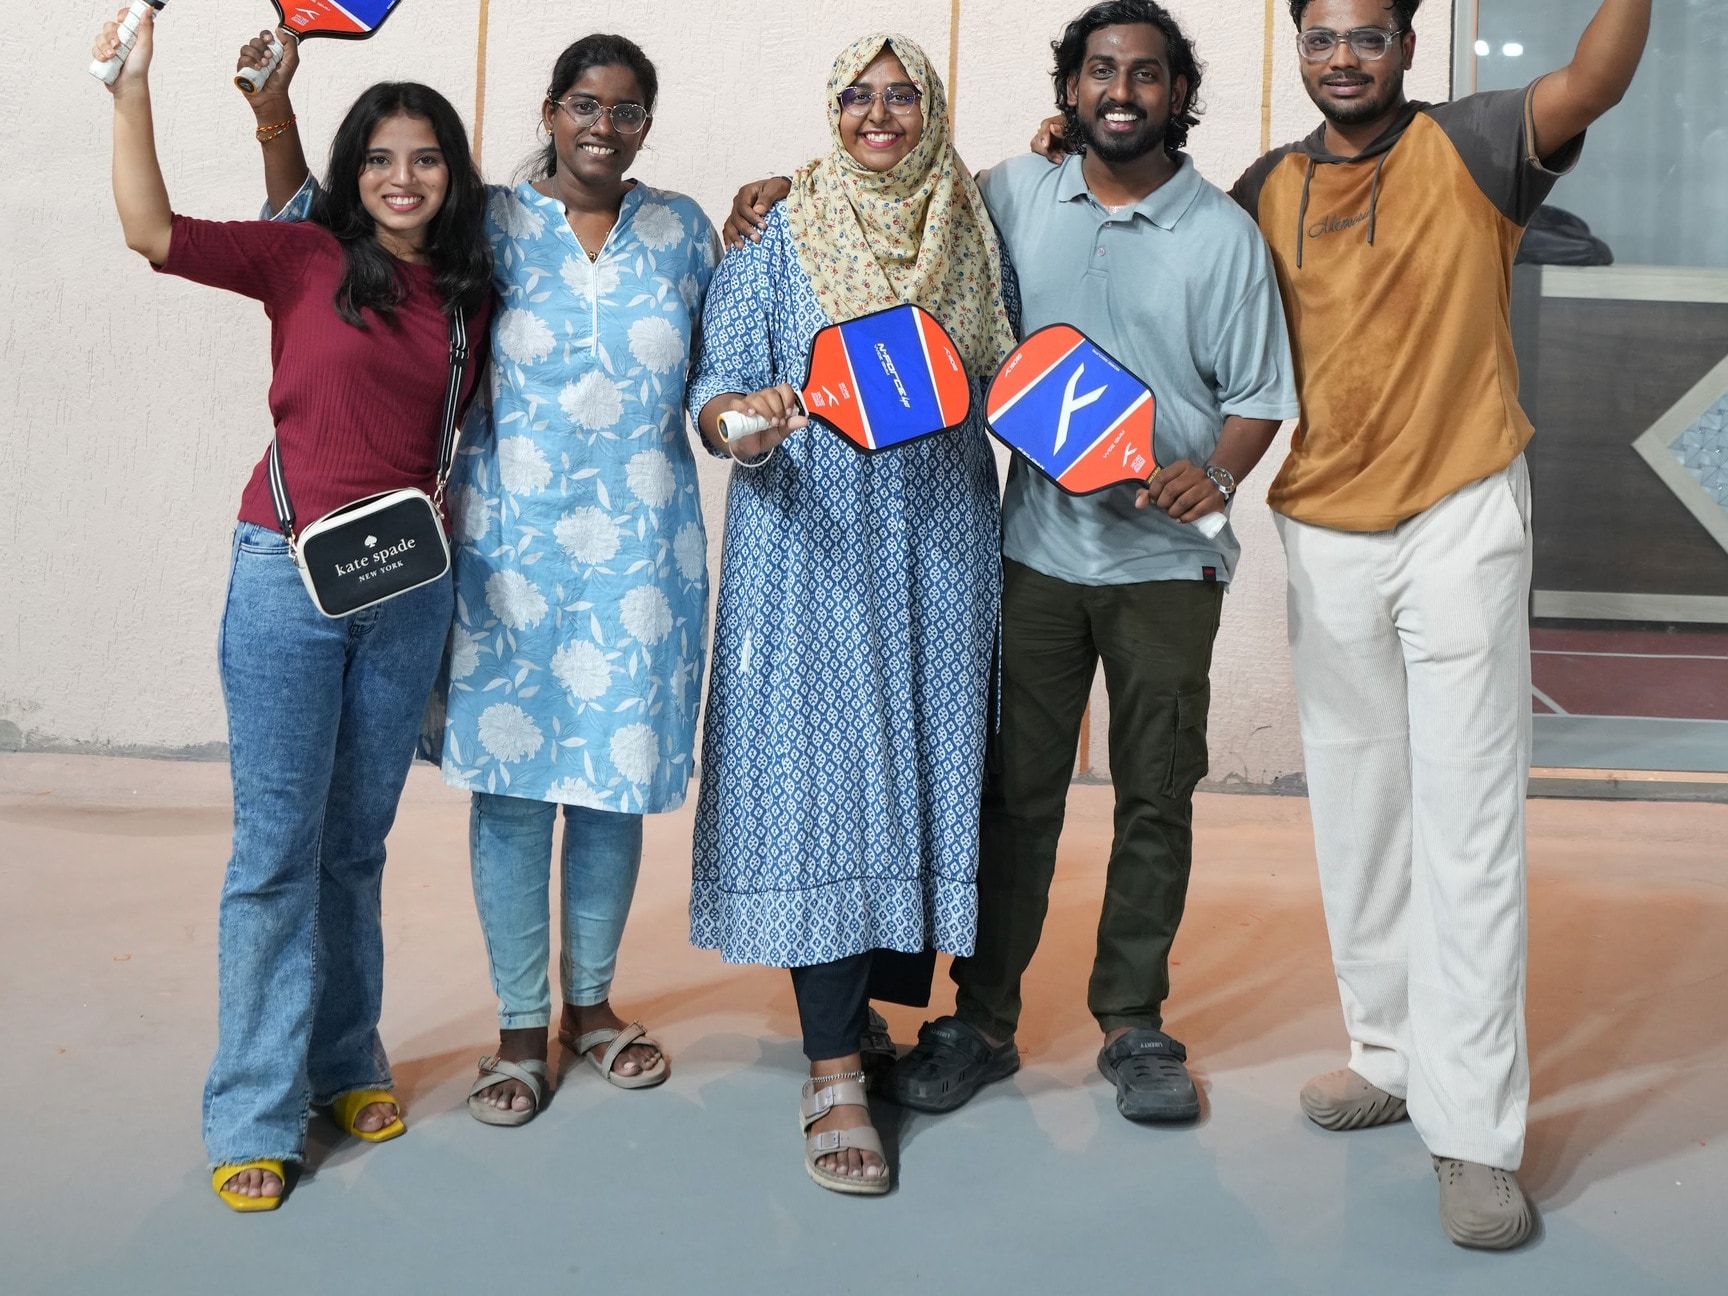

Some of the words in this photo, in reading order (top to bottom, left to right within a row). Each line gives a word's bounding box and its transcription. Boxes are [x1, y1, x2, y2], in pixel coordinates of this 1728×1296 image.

[335, 557, 369, 577] kate
[372, 538, 416, 564] spade
[358, 570, 377, 582] NEW
[380, 560, 404, 573] YORK
